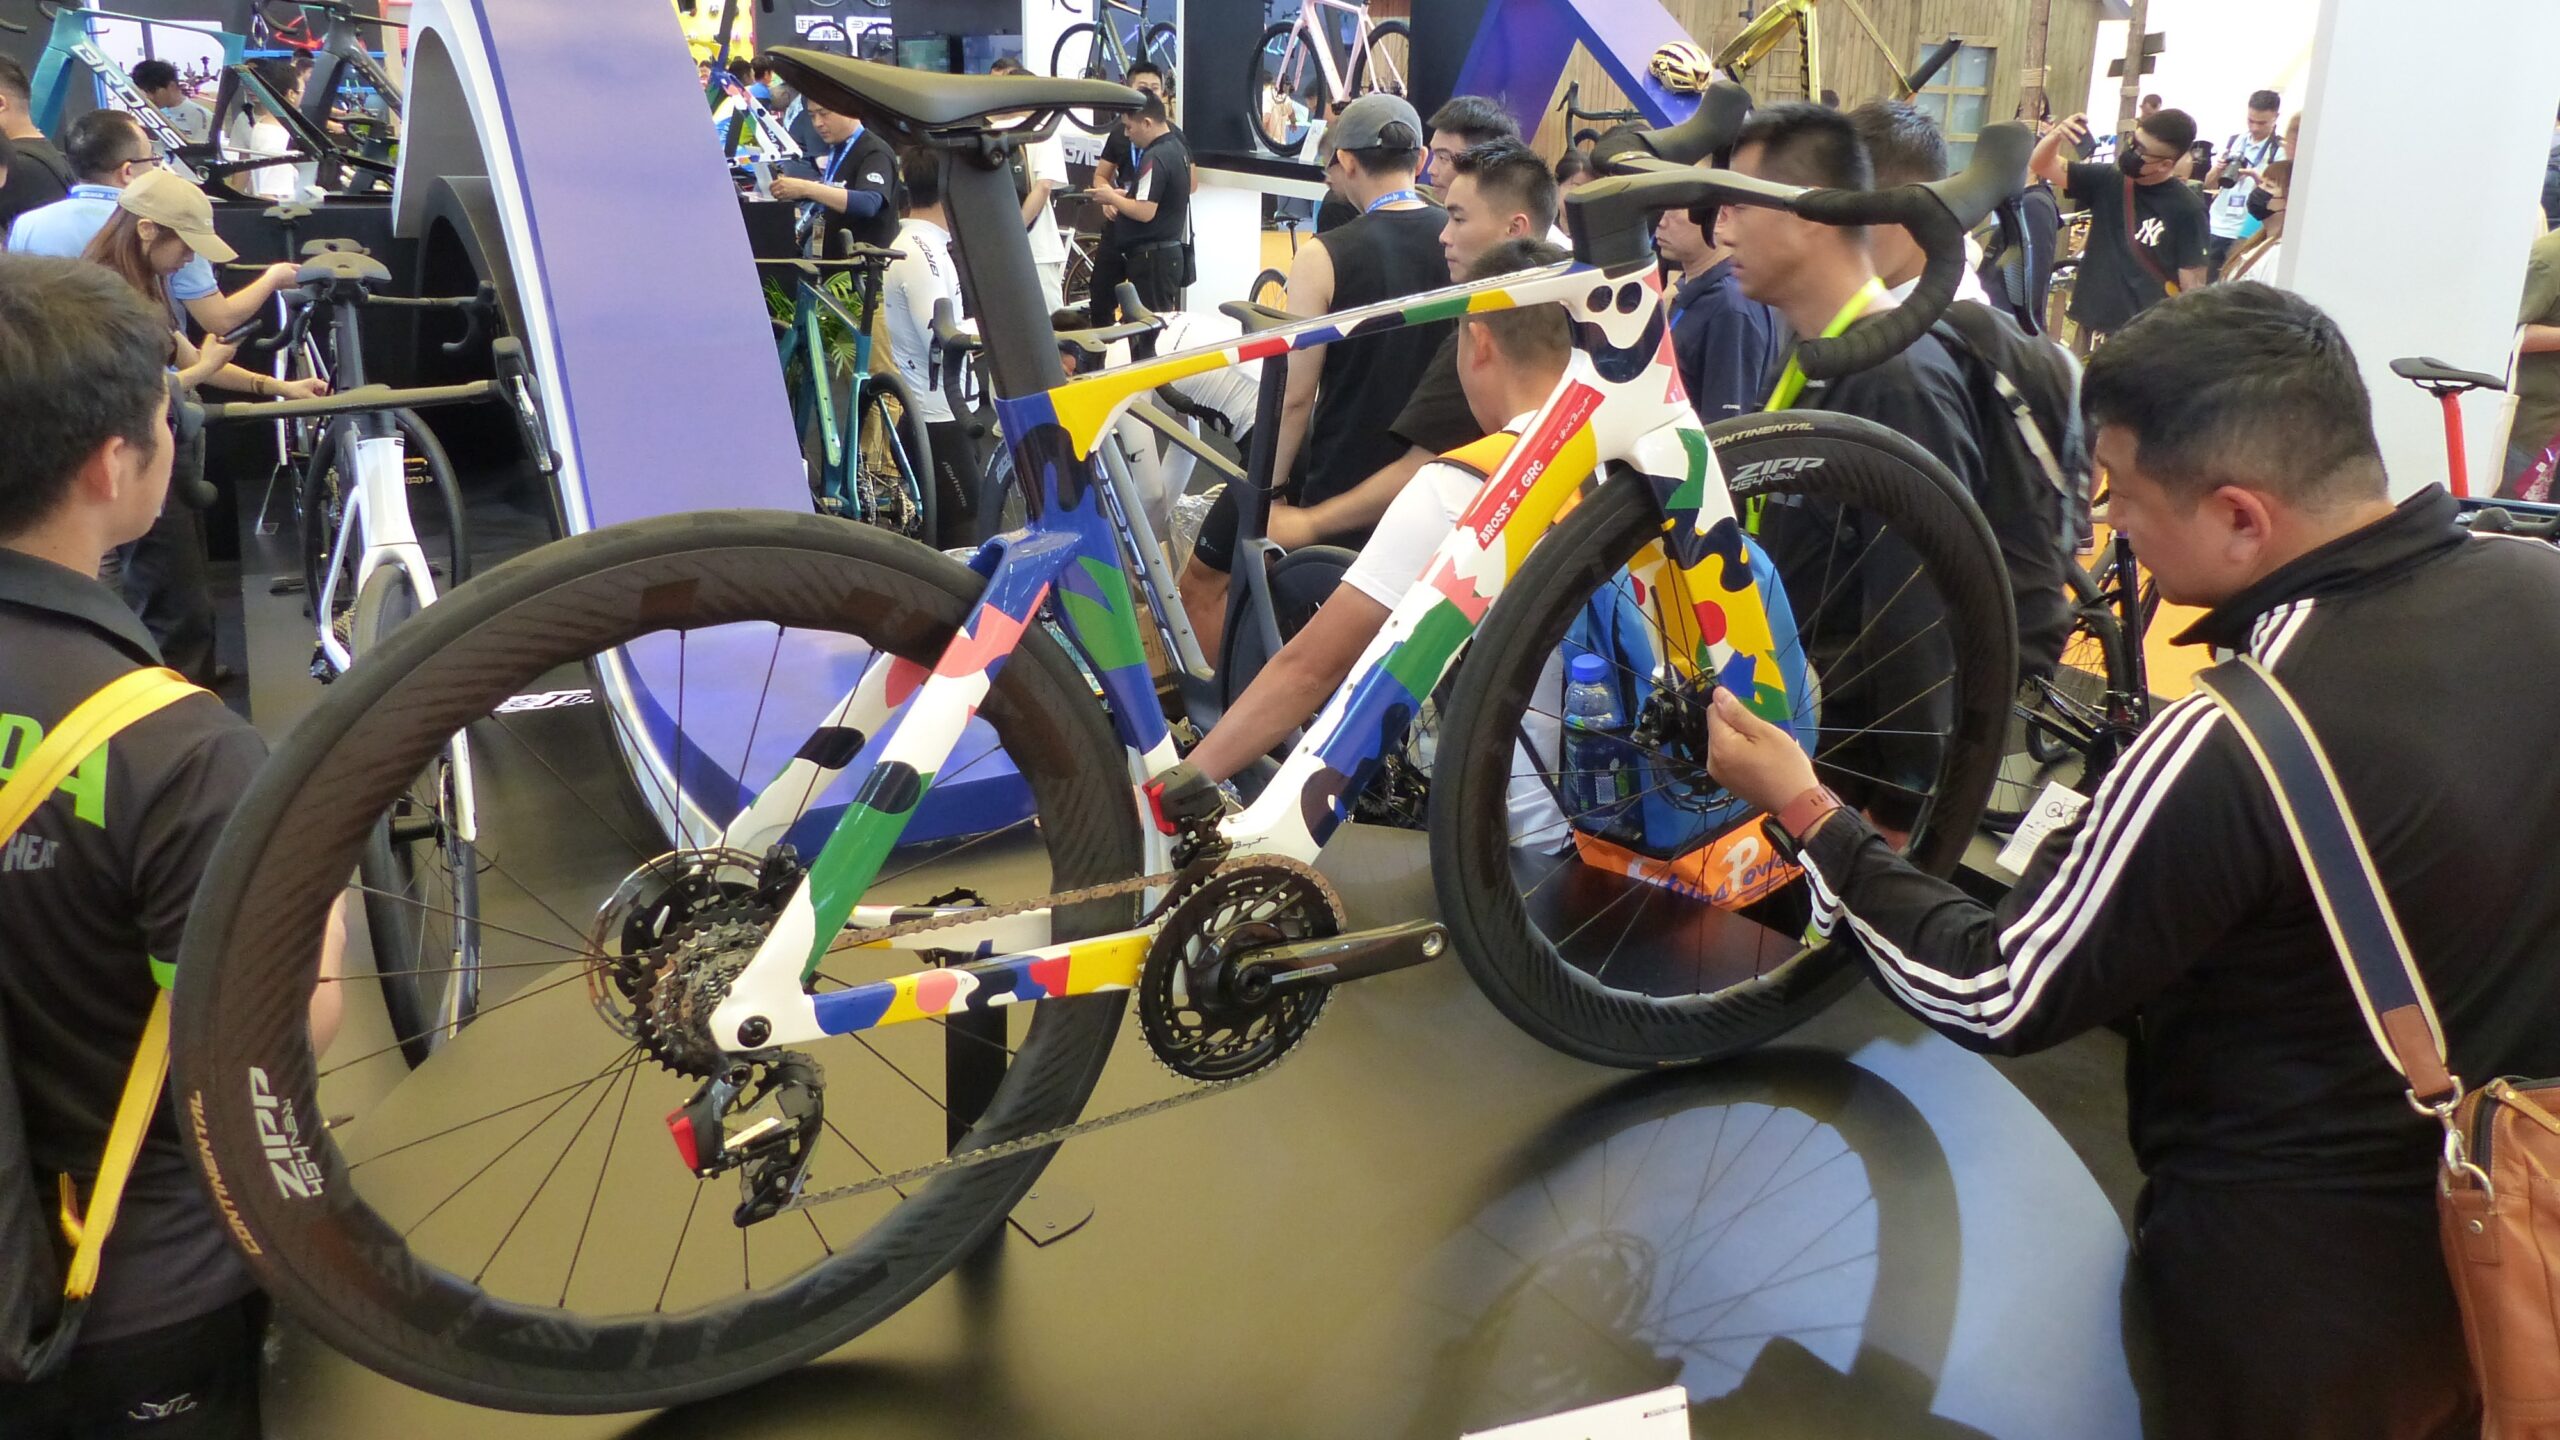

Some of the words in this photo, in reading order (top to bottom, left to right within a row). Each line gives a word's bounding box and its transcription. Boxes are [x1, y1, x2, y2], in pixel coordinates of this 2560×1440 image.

[70, 44, 188, 150] BROSS
[1711, 422, 1816, 448] ONTINENTAL
[1731, 457, 1826, 481] ZIPP
[1478, 502, 1512, 544] BROSS
[1520, 459, 1545, 488] GRC
[2, 831, 60, 873] HEAT
[189, 1089, 264, 1255] CONTINENTAL
[249, 1066, 311, 1199] ZIPP
